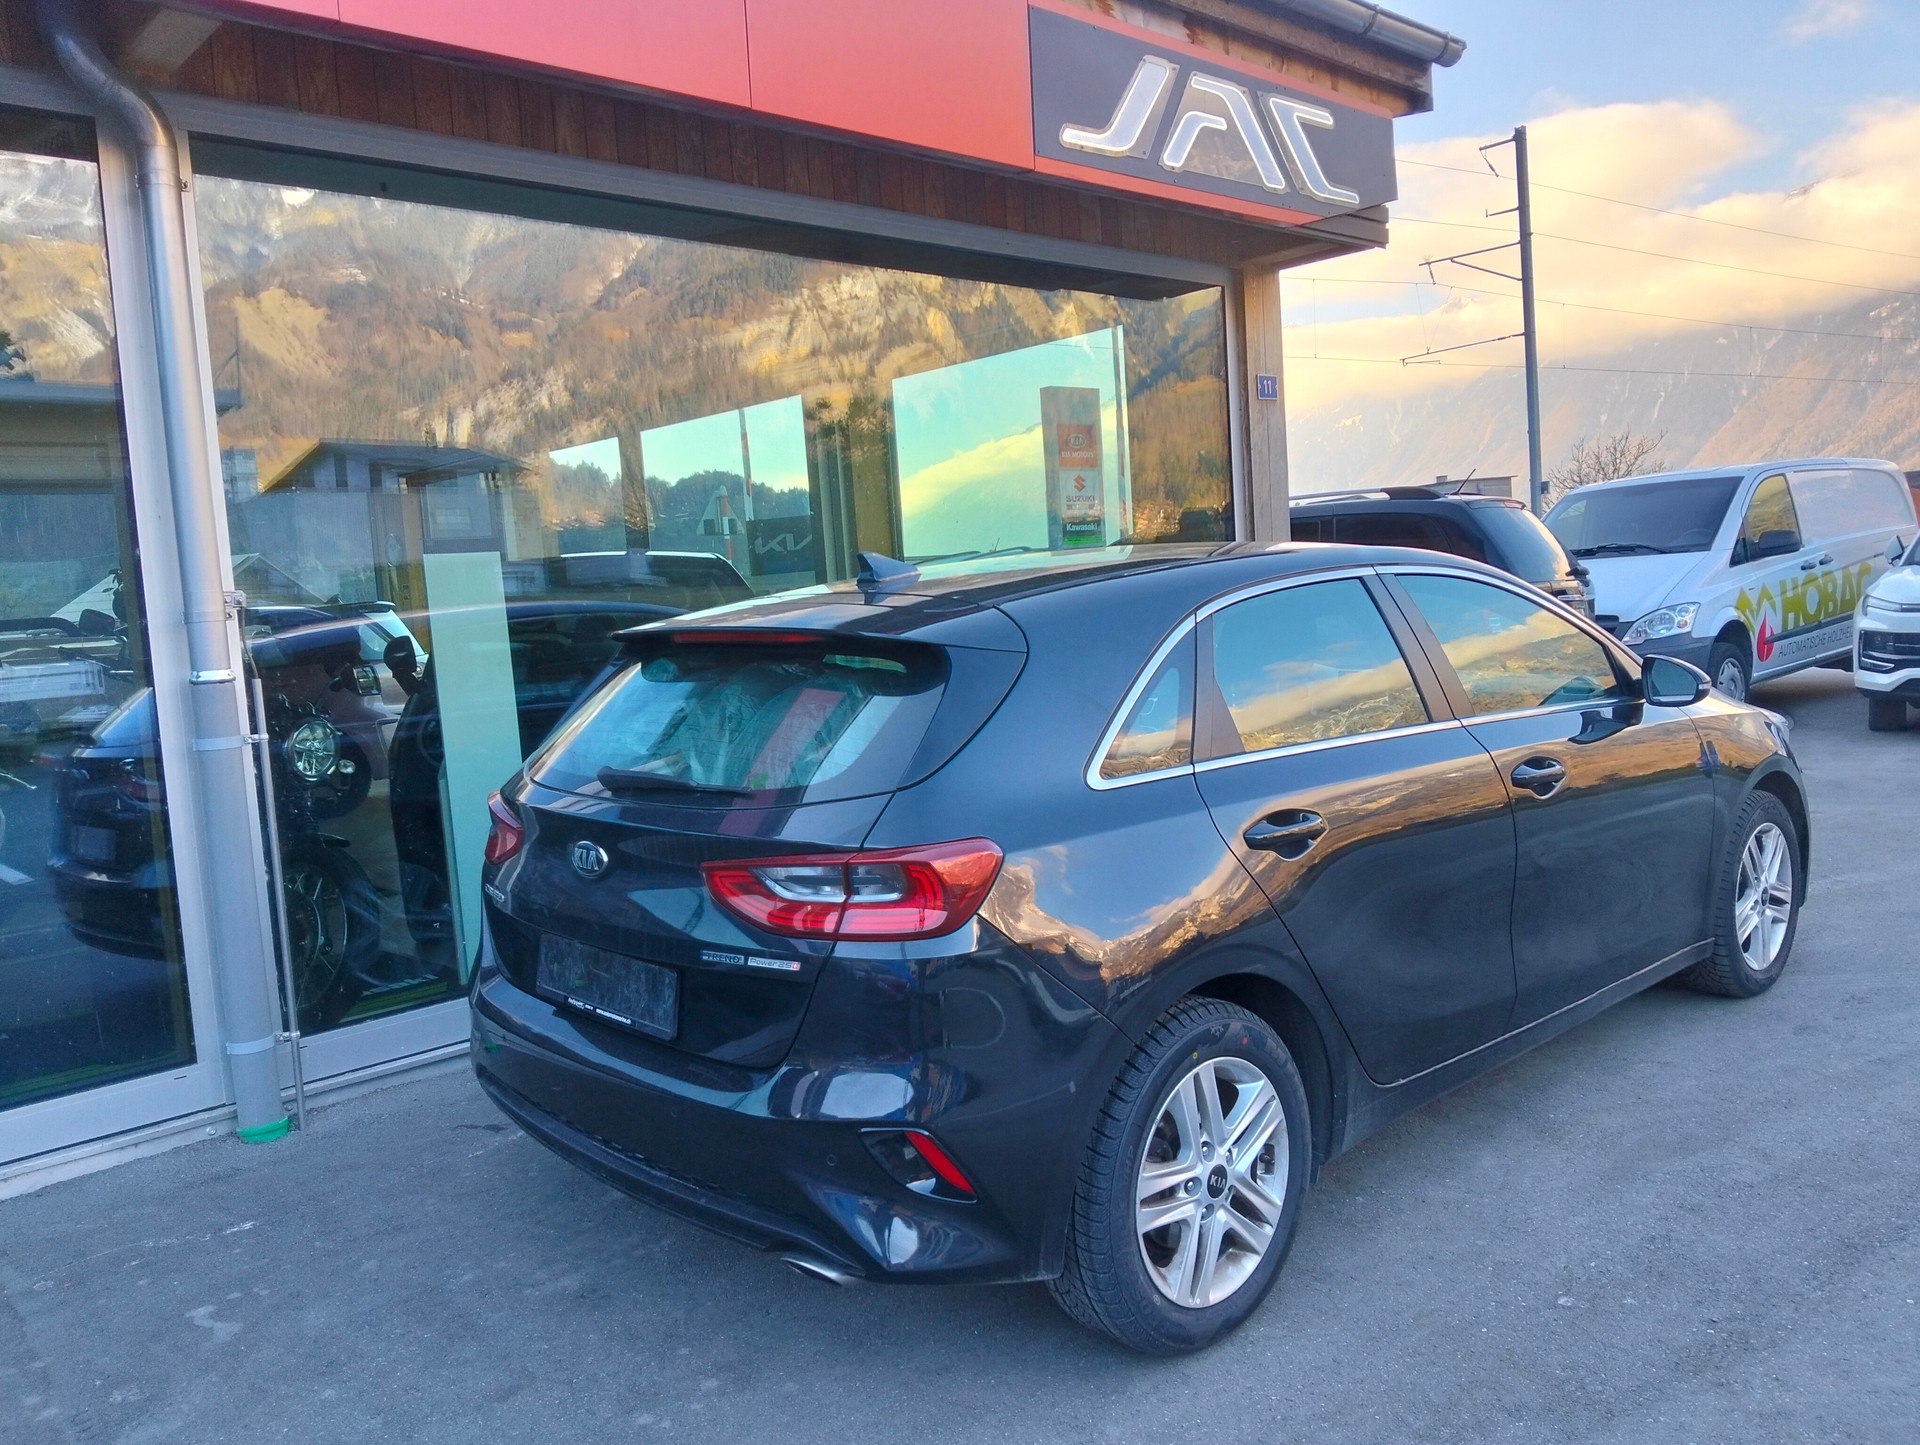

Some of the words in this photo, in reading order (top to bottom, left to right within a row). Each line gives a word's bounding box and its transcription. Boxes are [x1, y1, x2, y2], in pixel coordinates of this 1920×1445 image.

[1061, 60, 1359, 204] JAC
[1263, 379, 1272, 395] 11
[1066, 494, 1096, 503] SUZUKI
[1066, 522, 1098, 532] Kawasaki
[1778, 632, 1827, 658] AUTOMATISCHE
[574, 847, 599, 870] KIA
[706, 951, 740, 964] TREND
[1210, 1174, 1226, 1189] KIA
